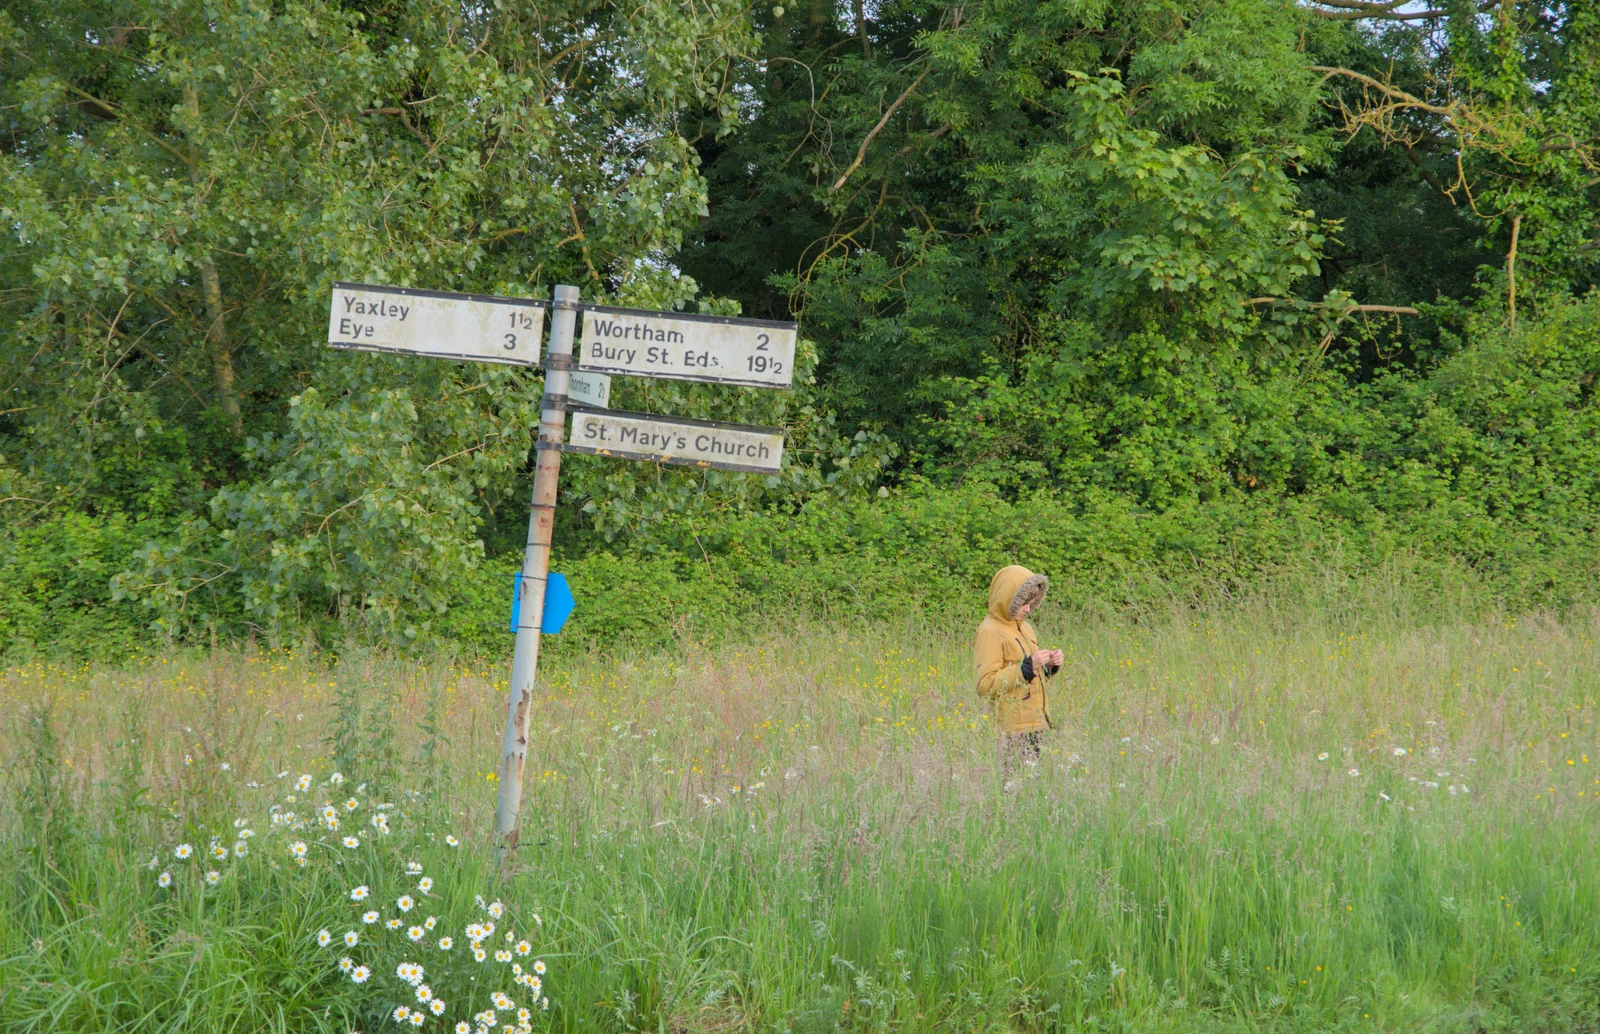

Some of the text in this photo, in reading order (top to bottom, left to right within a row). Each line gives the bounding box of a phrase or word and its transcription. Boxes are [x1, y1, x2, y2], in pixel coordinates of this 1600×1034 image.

[344, 296, 409, 321] Yaxley
[340, 318, 517, 350] Eye 3
[594, 319, 770, 351] Wortham 2
[592, 342, 636, 364] Bury
[646, 346, 673, 365] St.
[584, 422, 769, 459] St. Mary's Church
